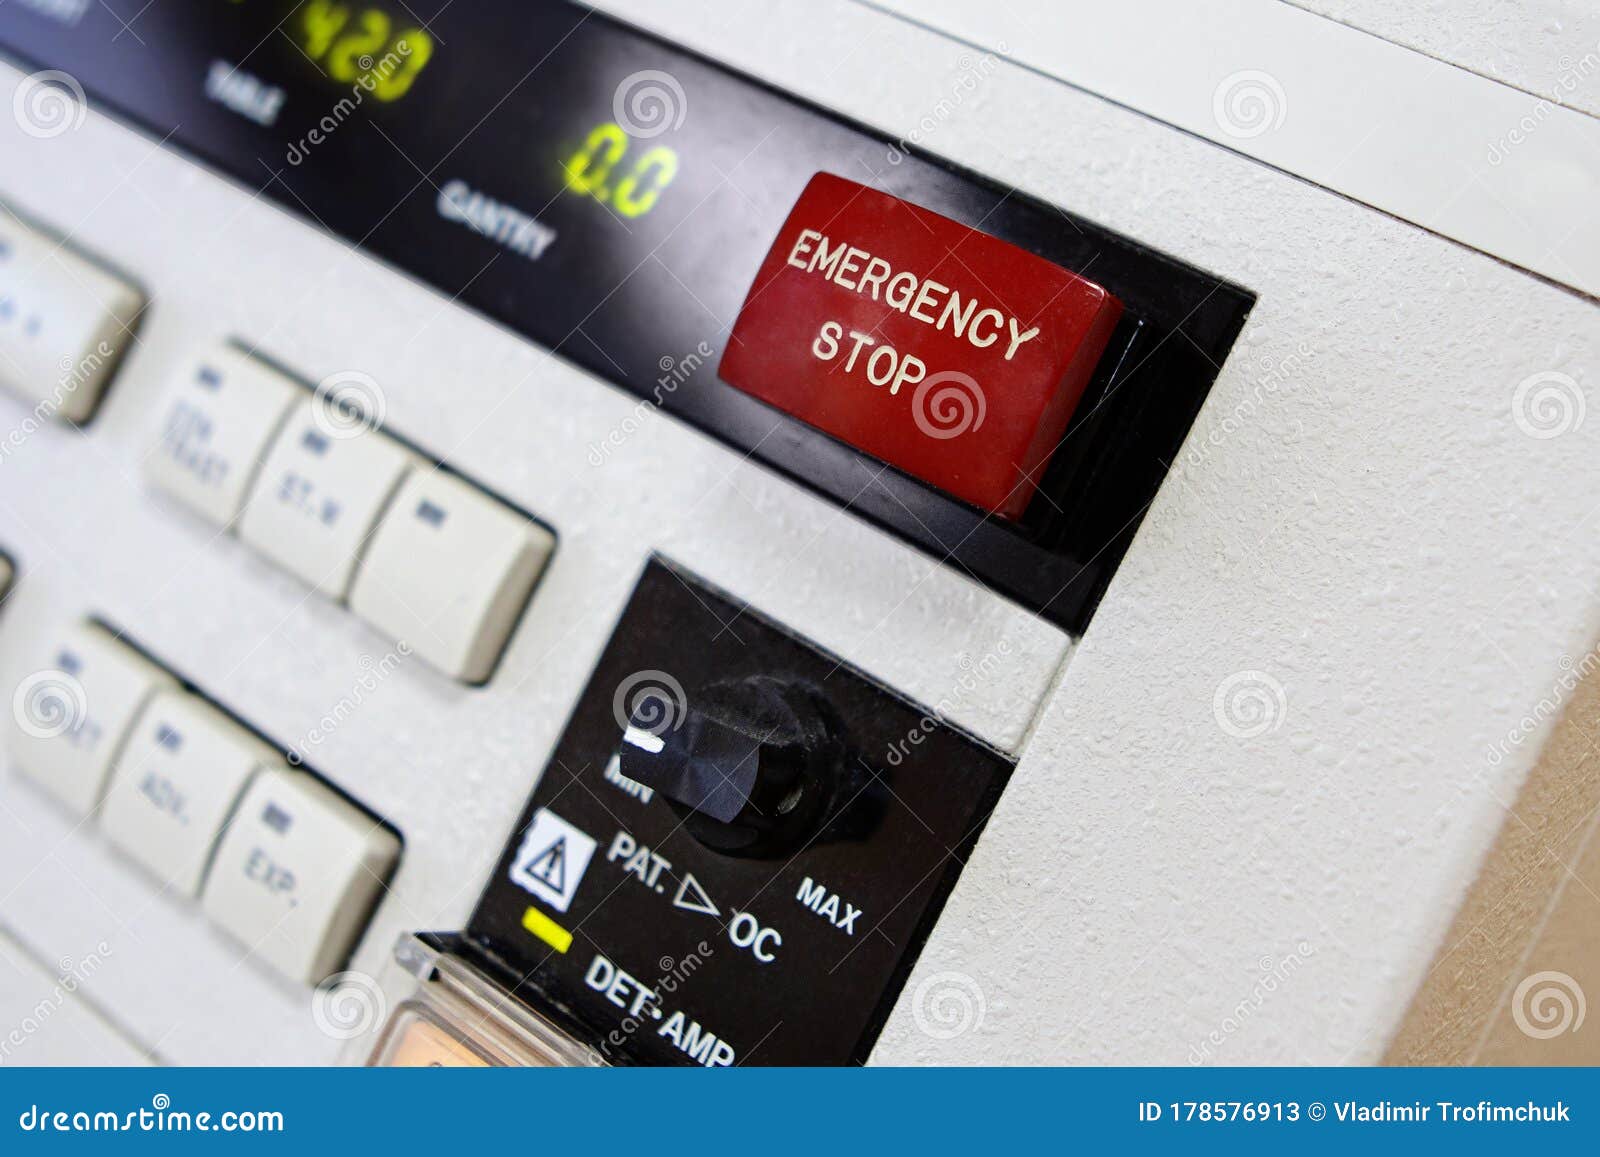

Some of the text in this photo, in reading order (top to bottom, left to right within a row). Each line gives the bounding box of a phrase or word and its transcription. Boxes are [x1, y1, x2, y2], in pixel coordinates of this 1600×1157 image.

[564, 121, 678, 219] 0.0
[787, 229, 1041, 361] EMERGENCY
[812, 320, 927, 396] STOP
[605, 831, 783, 963] PAT. OC
[796, 876, 863, 935] MAX
